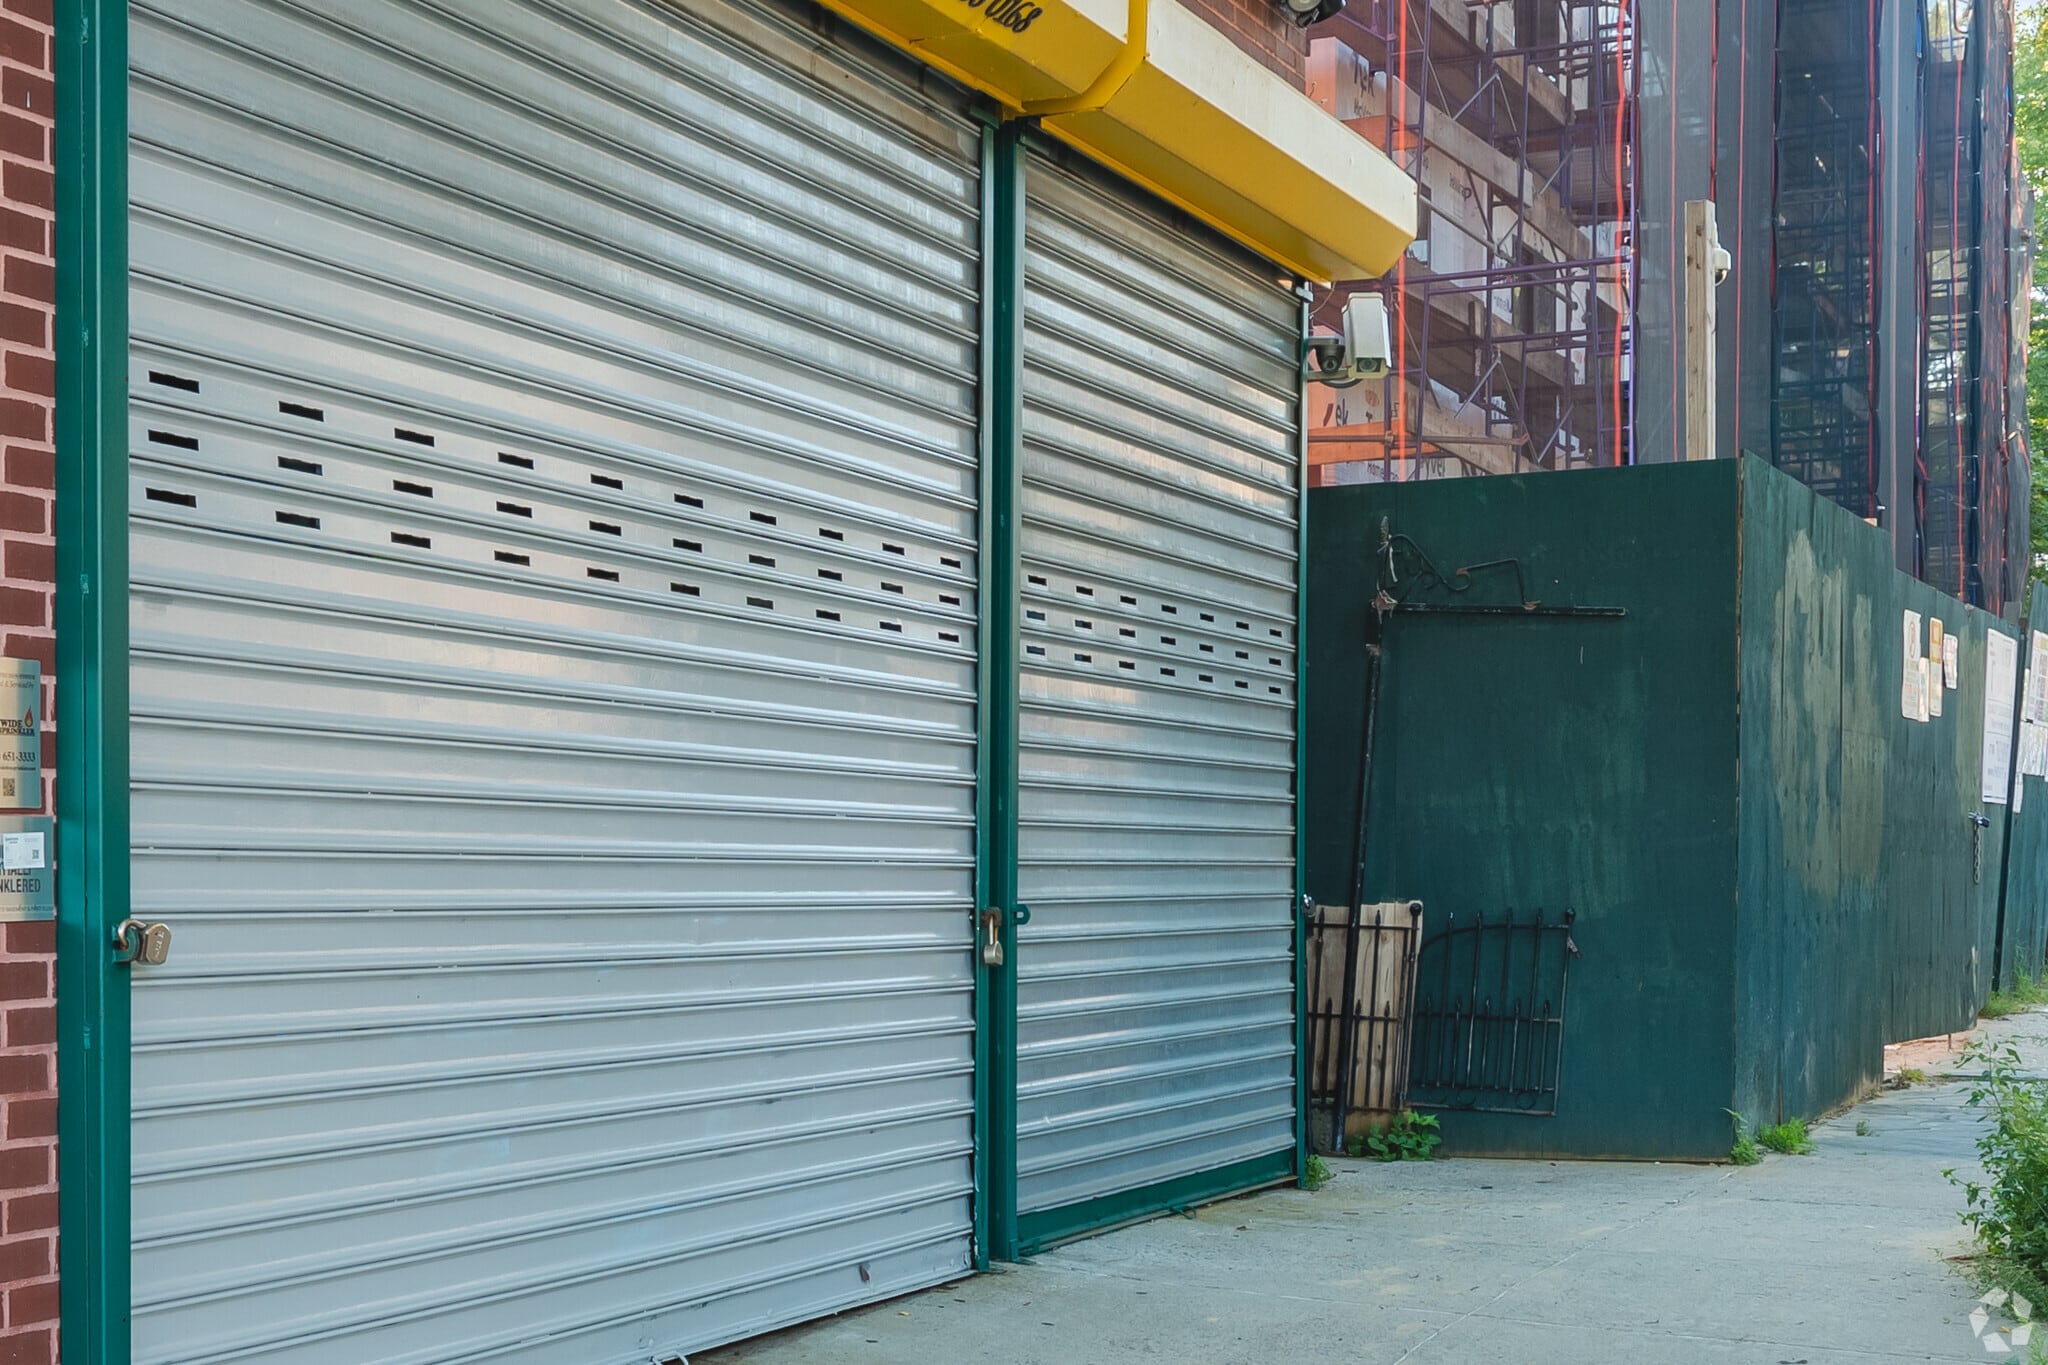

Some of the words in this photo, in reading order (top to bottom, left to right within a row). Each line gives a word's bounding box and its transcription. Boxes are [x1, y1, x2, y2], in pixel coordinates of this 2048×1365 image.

[984, 0, 1043, 33] 0168
[0, 719, 23, 728] WIDE
[2, 751, 36, 762] 651-3333
